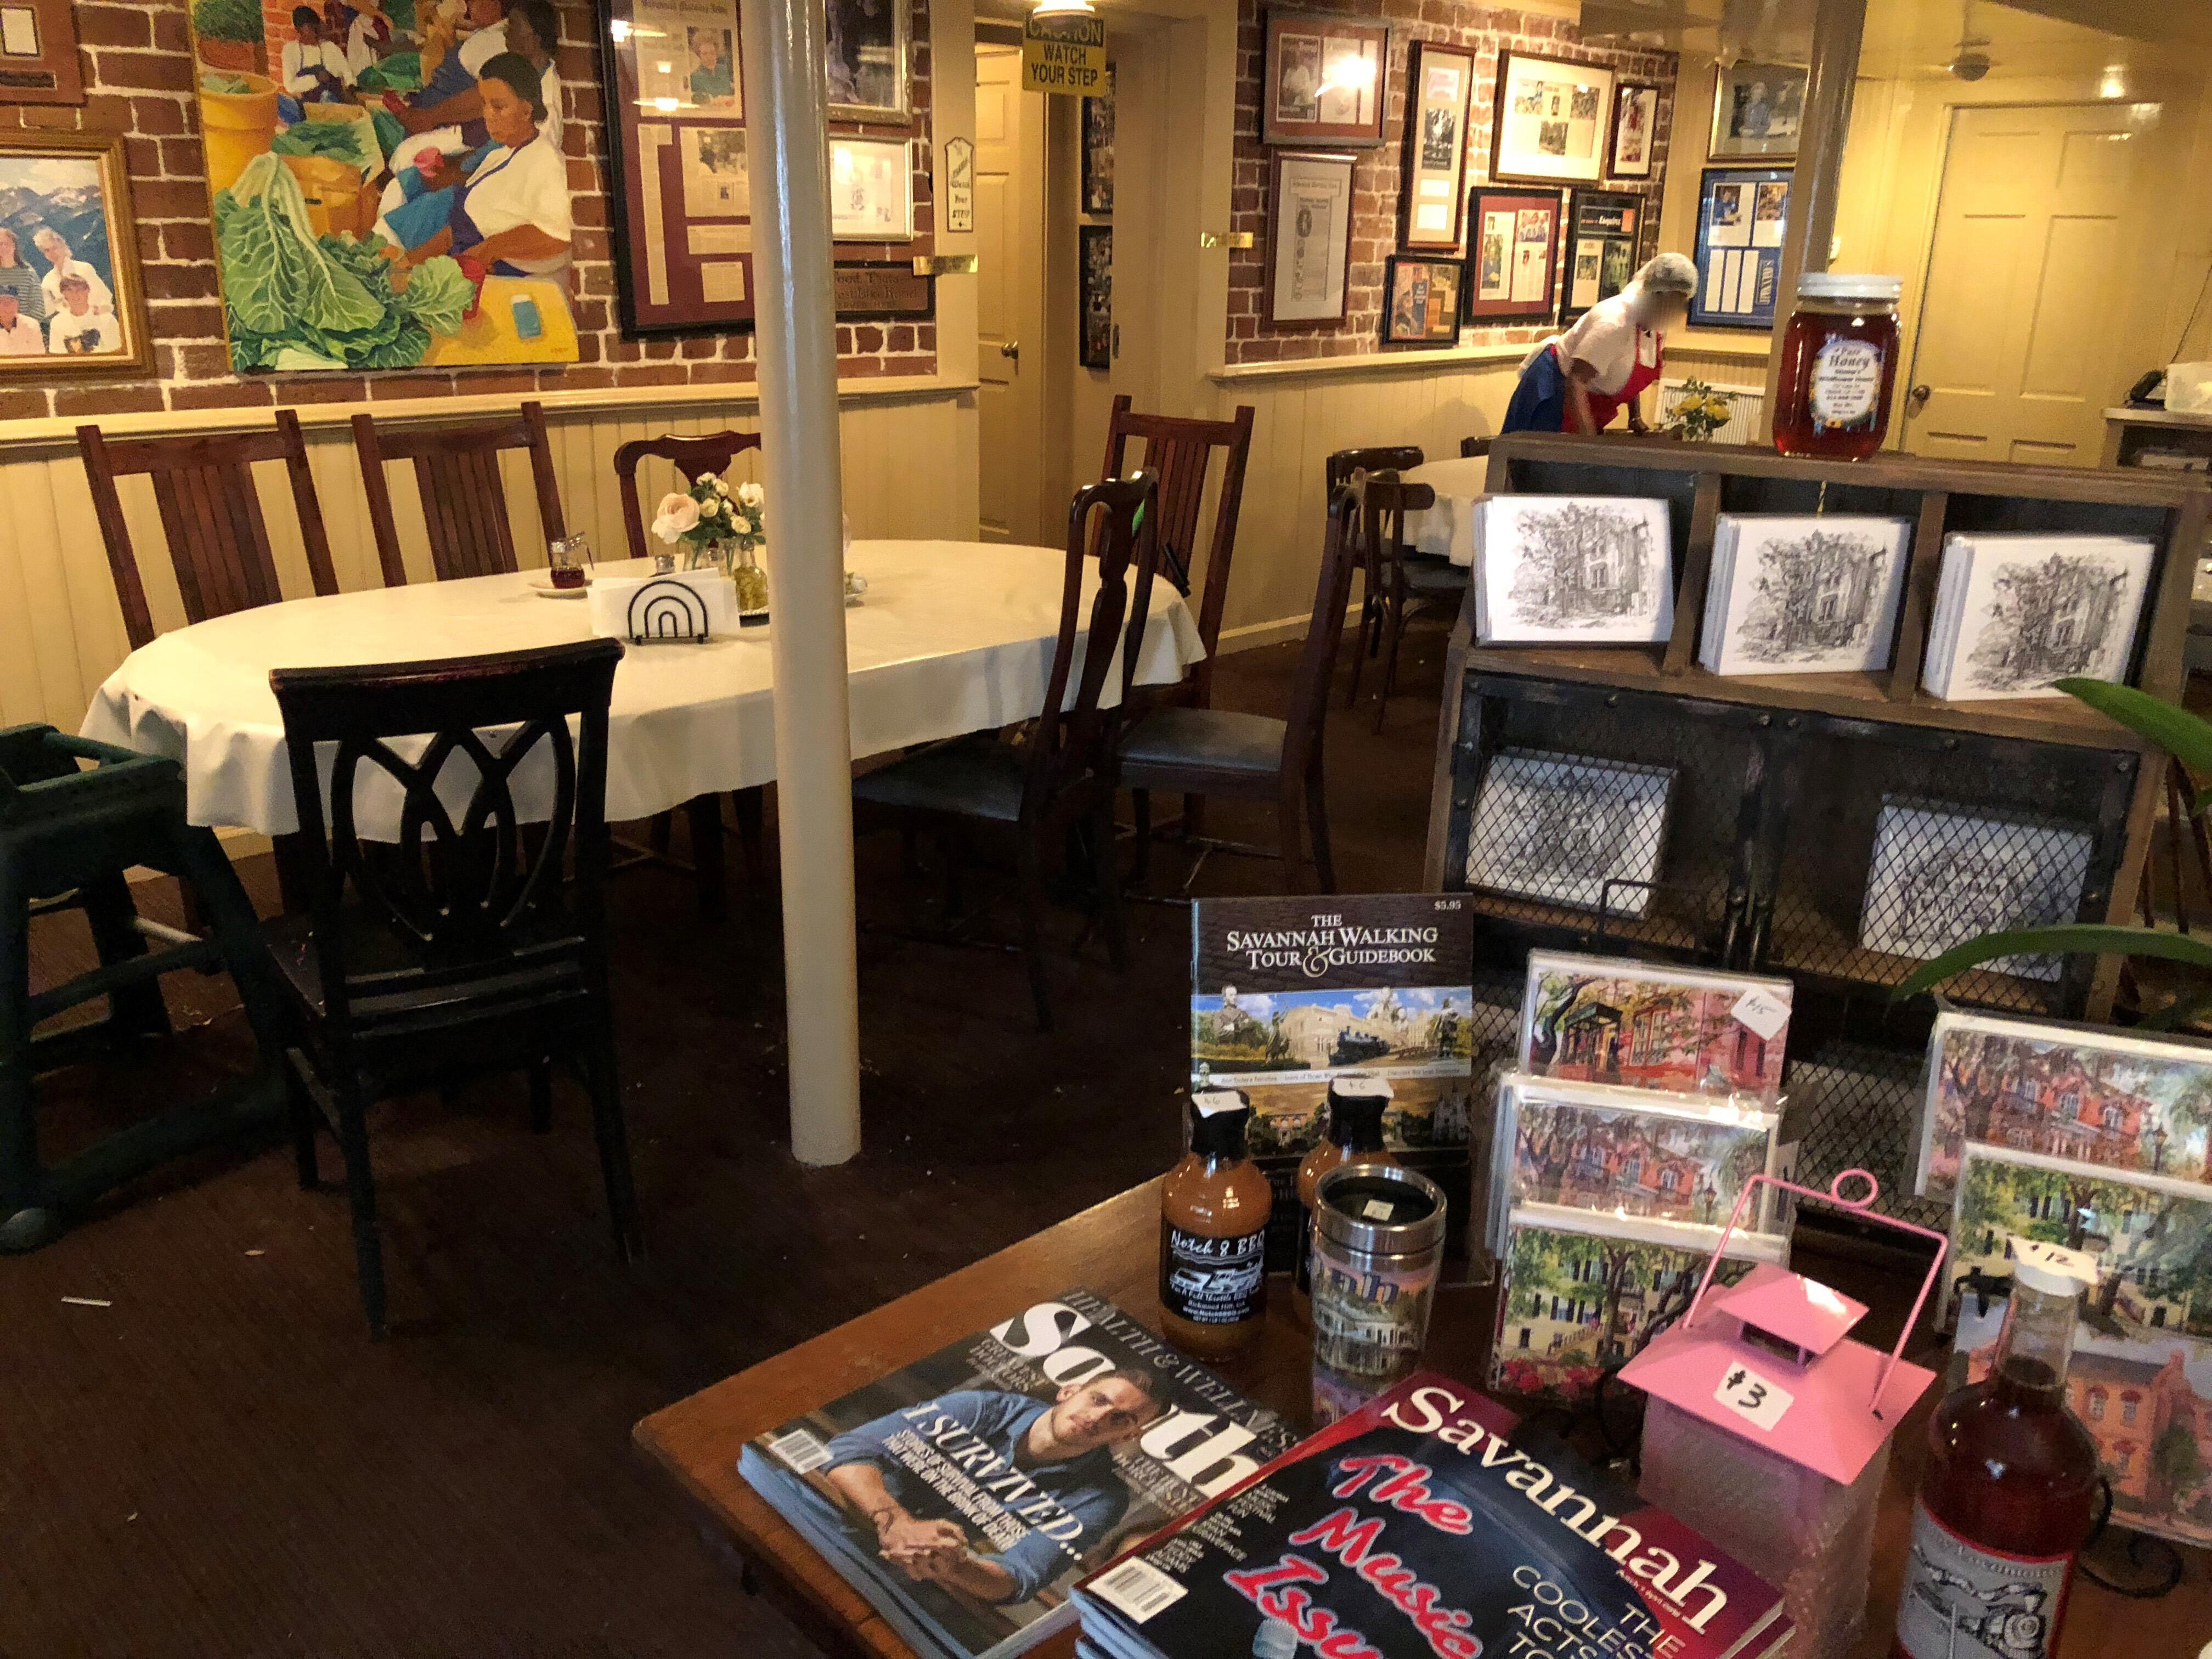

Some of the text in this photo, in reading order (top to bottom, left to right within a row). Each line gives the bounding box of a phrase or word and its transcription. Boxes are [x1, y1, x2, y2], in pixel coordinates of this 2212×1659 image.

[1044, 44, 1086, 65] WATCH
[1031, 62, 1098, 87] YOUR STEP
[1829, 355, 1870, 370] Honey
[1311, 914, 1342, 927] THE
[1435, 900, 1462, 911] $5.95
[1227, 926, 1438, 952] SAVANNAH WALKING
[1246, 945, 1436, 978] TOUR & GUIDEBOOK
[1171, 1229, 1214, 1255] Notch
[1220, 1240, 1230, 1257] 8
[1063, 1290, 1164, 1356] HEALTH
[1153, 1353, 1180, 1368] &
[989, 1302, 1261, 1500] Soth
[1726, 1370, 1768, 1408] $3
[902, 1402, 940, 1420] I
[1333, 1454, 1474, 1536] The
[1380, 1386, 1728, 1635] Savannah
[1288, 1506, 1483, 1659] Music
[1513, 1565, 1651, 1659] COOLES
[1620, 1602, 1686, 1659] THE
